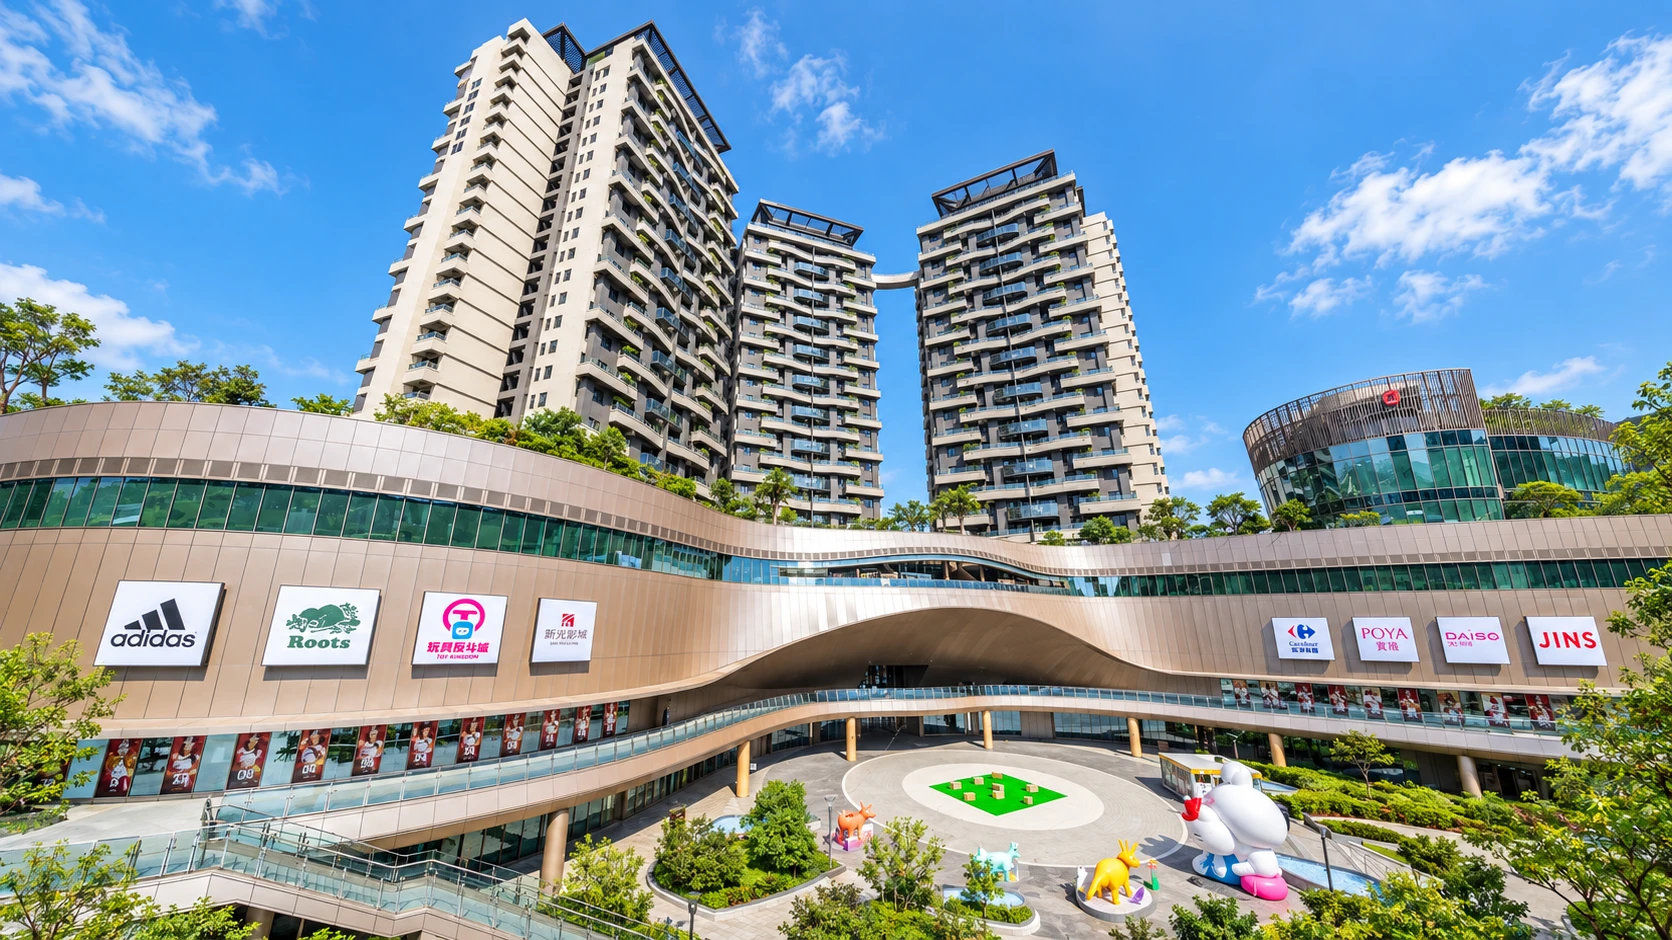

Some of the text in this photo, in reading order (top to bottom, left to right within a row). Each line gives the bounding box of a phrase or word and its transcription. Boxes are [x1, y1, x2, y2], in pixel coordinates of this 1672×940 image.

[110, 629, 196, 648] adidas
[1361, 627, 1409, 640] POYA
[1445, 630, 1499, 641] DAISO
[1539, 631, 1597, 649] JINS
[287, 635, 351, 649] Roots
